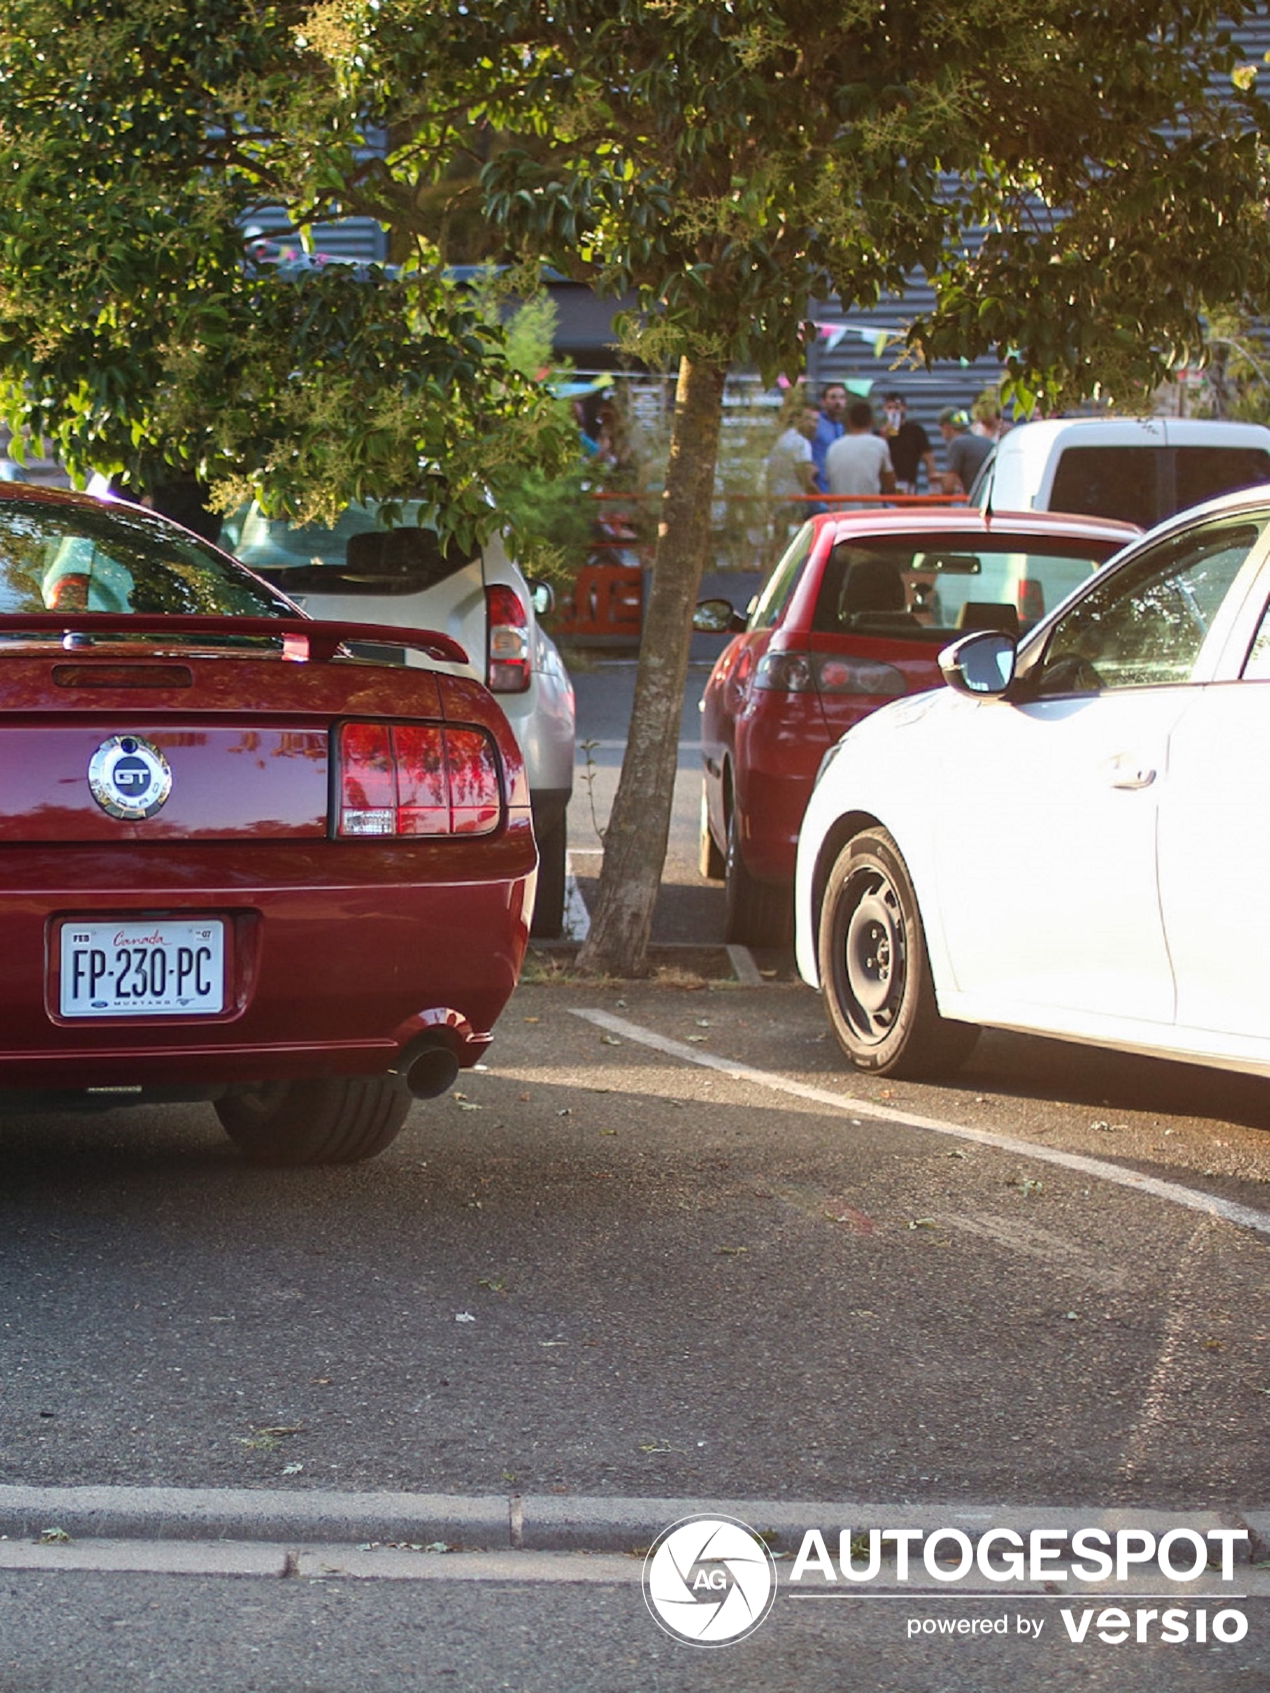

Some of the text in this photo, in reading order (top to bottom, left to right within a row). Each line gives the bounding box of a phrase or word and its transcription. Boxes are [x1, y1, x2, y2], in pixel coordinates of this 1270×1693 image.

[114, 769, 150, 785] GT
[113, 929, 173, 947] Canada
[72, 946, 212, 999] FP-230-PC
